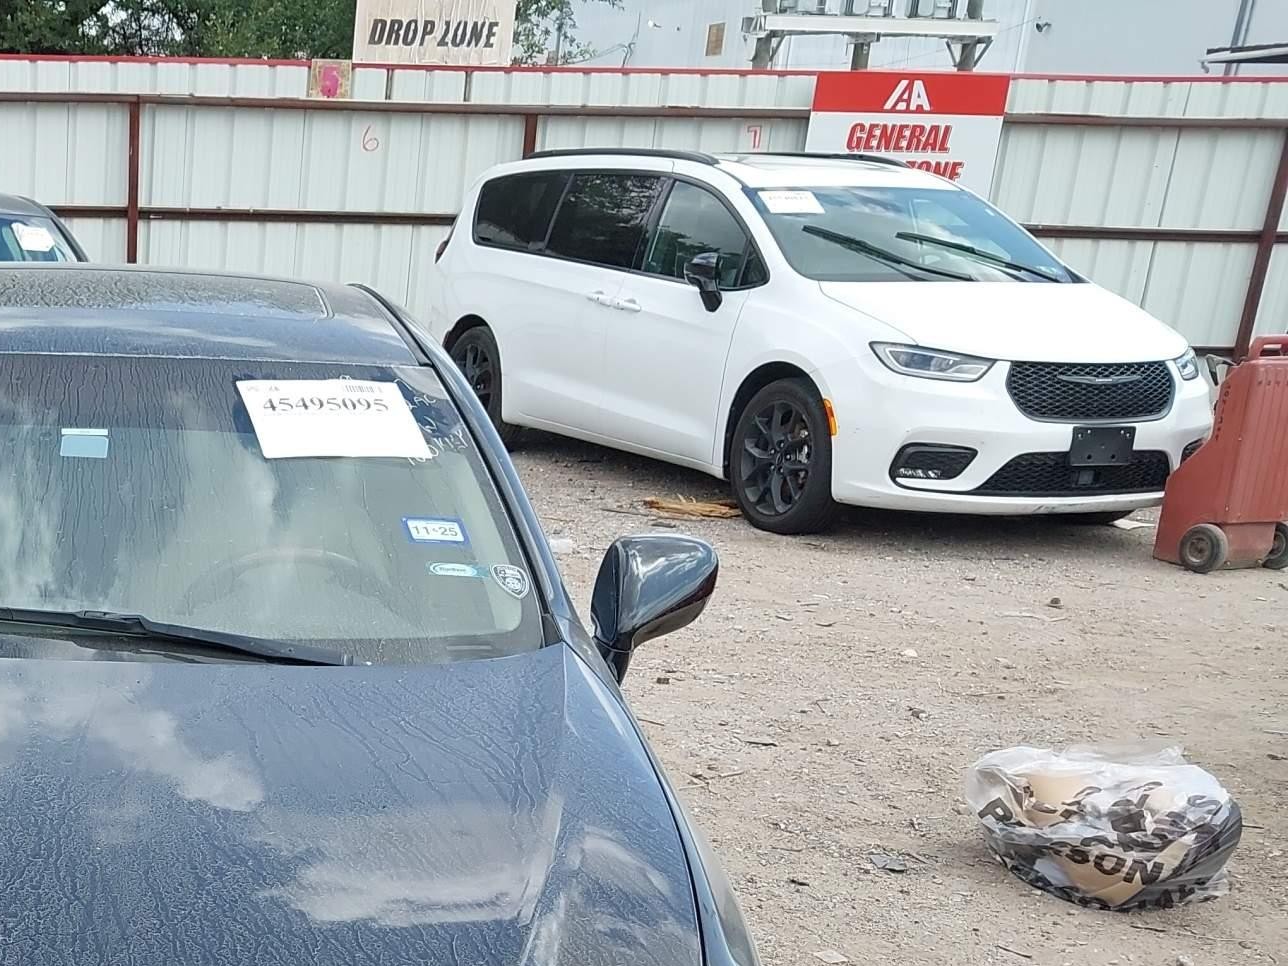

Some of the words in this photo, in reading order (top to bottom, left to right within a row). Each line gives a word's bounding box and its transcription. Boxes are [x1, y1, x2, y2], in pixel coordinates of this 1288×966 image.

[368, 18, 436, 47] DROP
[437, 19, 500, 48] ZONE
[362, 124, 380, 152] 6
[846, 122, 953, 153] GENERAL
[263, 397, 389, 412] 45495095
